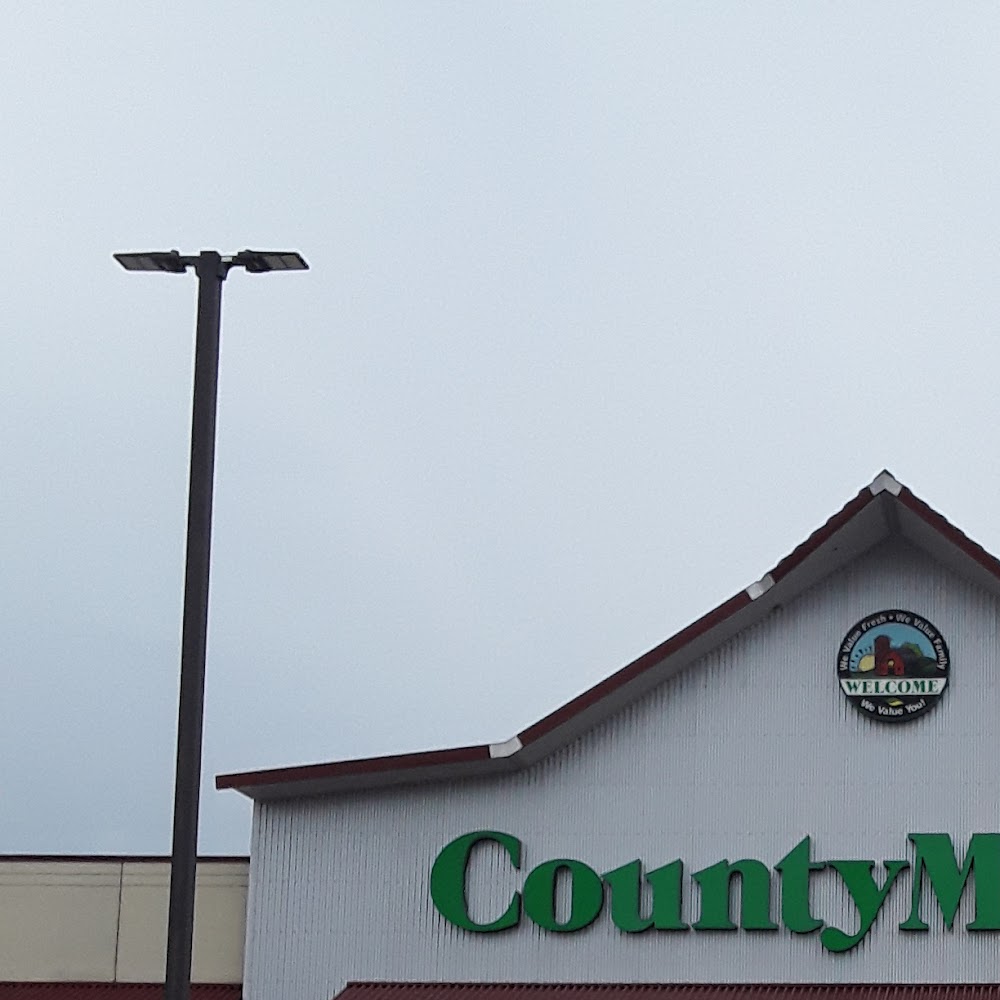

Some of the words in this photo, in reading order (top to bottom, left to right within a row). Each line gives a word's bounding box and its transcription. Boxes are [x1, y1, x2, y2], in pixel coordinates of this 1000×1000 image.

[861, 614, 887, 631] Fresh
[843, 630, 861, 653] Value
[895, 613, 911, 624] We
[913, 618, 935, 639] Value
[933, 638, 948, 670] Family
[839, 655, 848, 671] We
[845, 680, 939, 694] WELCOME
[860, 698, 876, 712] We
[877, 705, 904, 716] Value
[905, 698, 926, 713] You!
